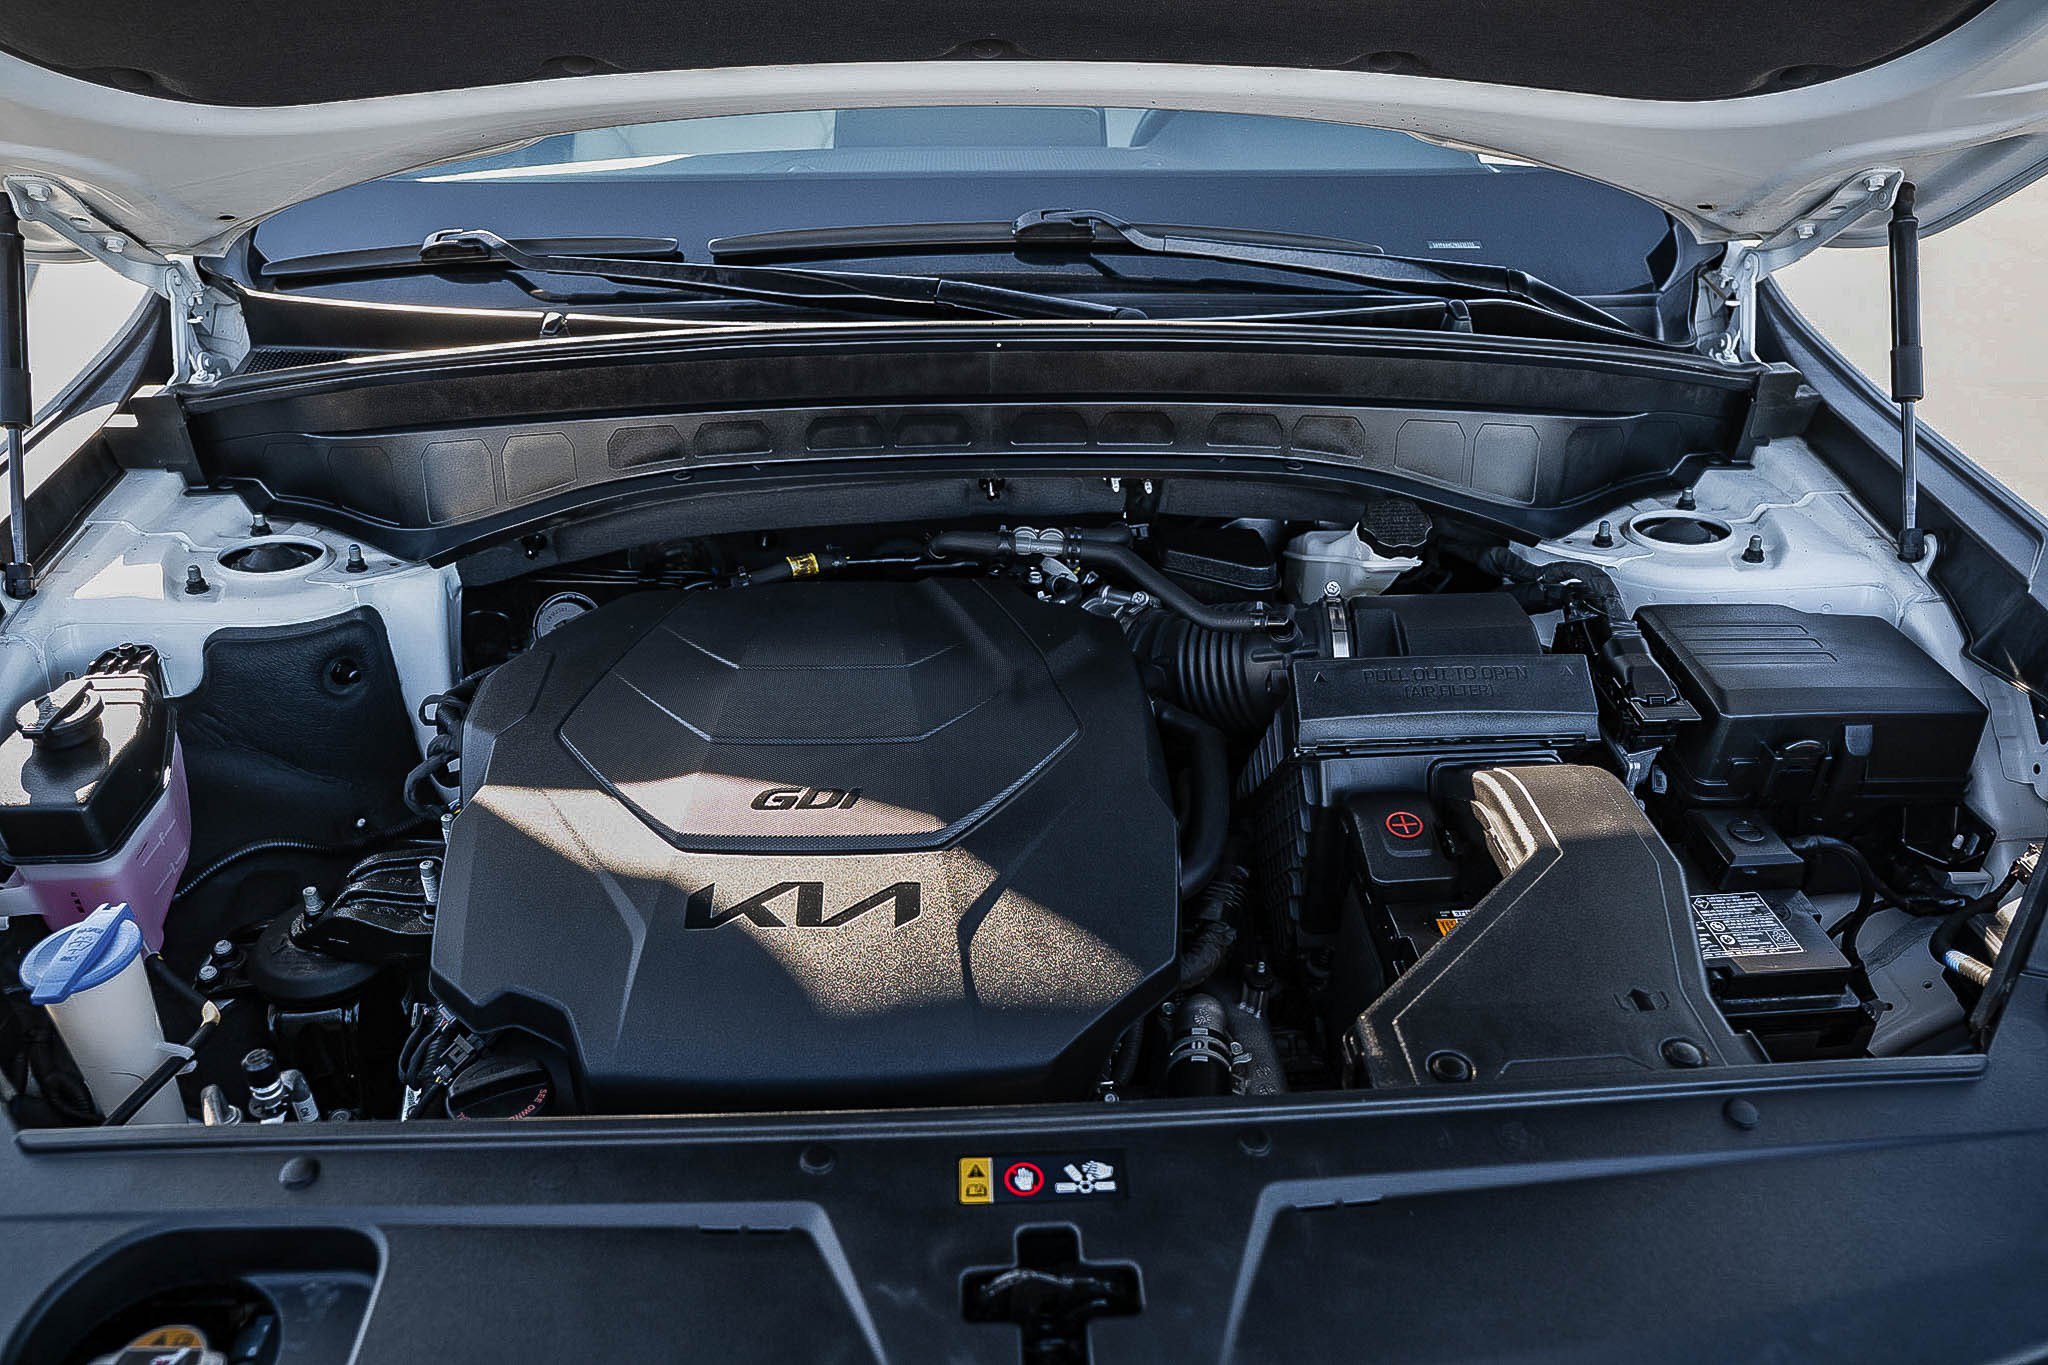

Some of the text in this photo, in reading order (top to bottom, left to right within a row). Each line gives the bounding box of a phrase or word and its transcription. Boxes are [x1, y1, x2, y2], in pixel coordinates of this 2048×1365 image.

[1362, 664, 1528, 683] PULL OUT TO OPEN
[750, 787, 863, 811] GDI
[683, 881, 921, 930] KIA
